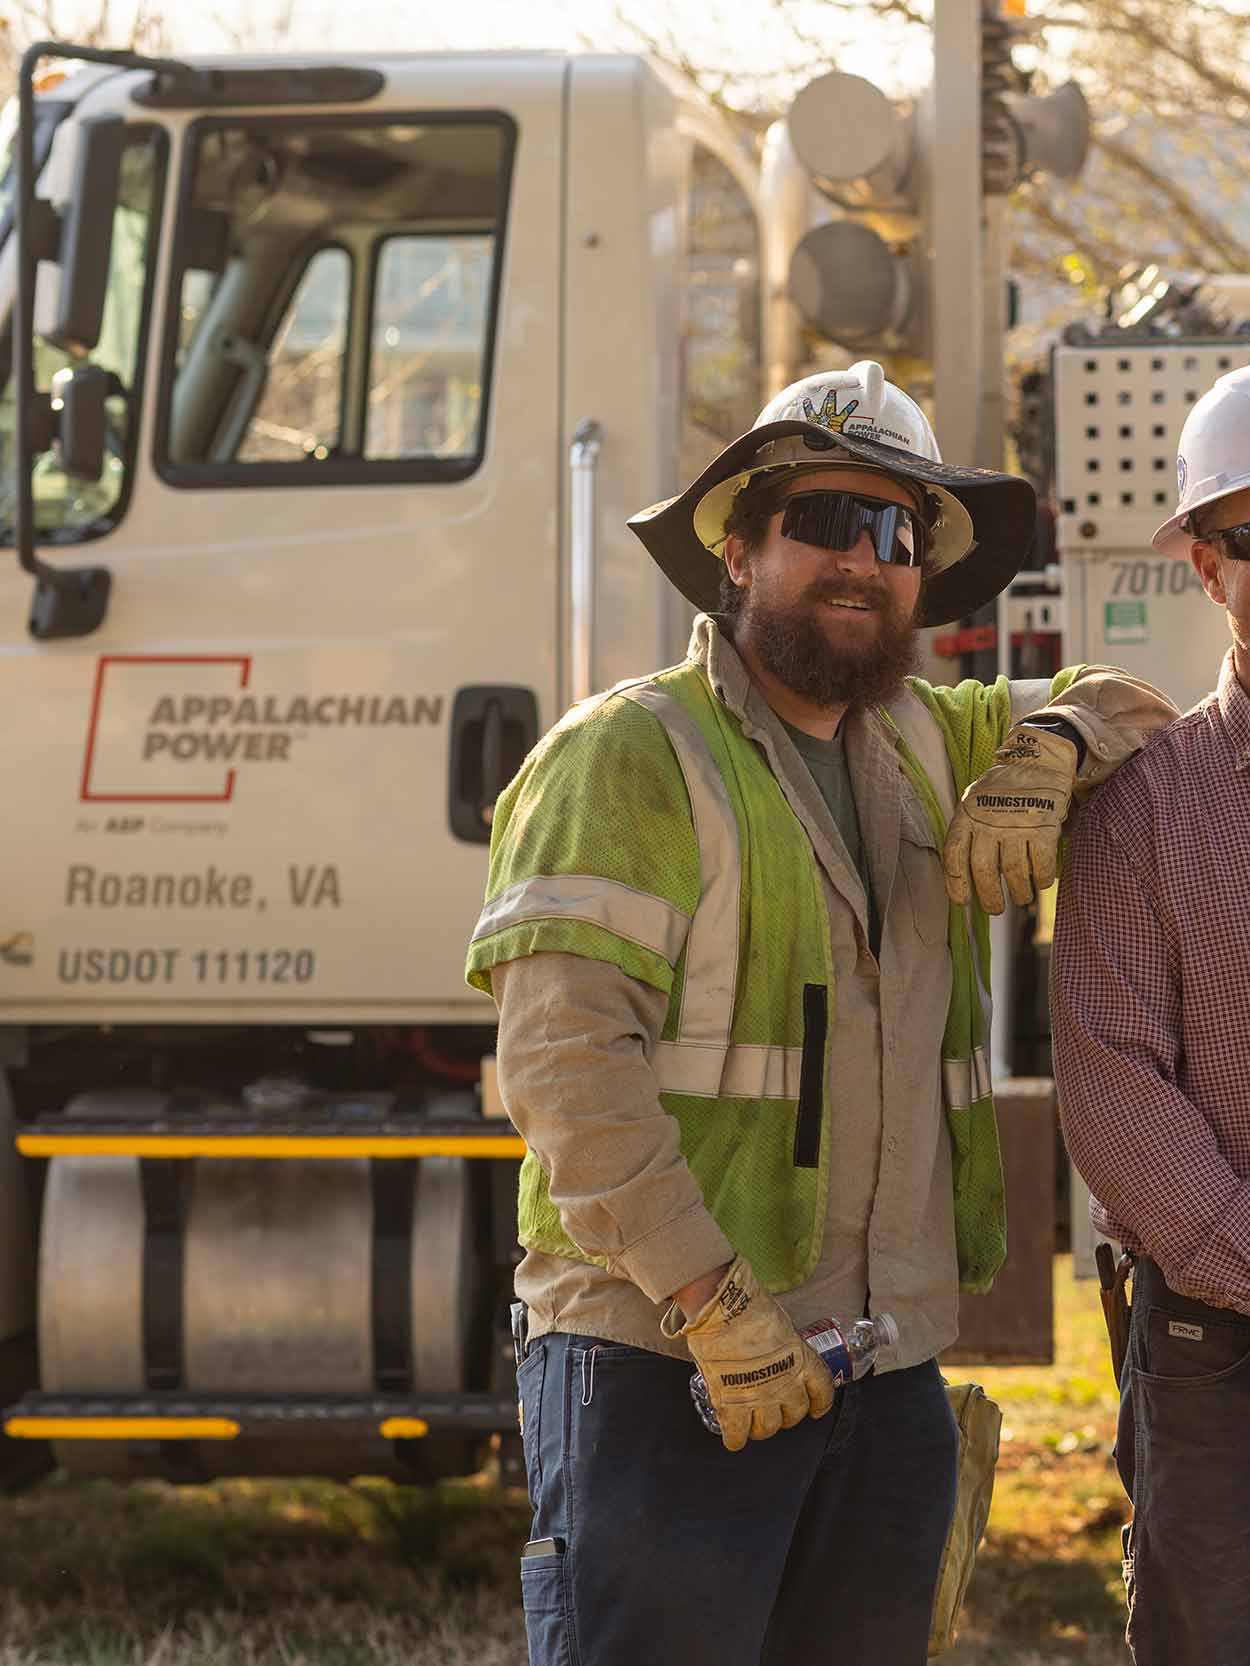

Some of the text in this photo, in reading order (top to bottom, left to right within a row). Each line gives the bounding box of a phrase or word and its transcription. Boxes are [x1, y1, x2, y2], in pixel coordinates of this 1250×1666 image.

[848, 423, 910, 445] APPALACHIAN
[149, 695, 444, 726] APPALACHIAN
[141, 731, 292, 762] POWER
[976, 795, 1055, 811] YOUNGSTOWN
[65, 864, 341, 914] Roanoke, VA
[57, 948, 315, 984] USDOT 111120
[721, 1352, 795, 1386] YOUNGSTOWN
